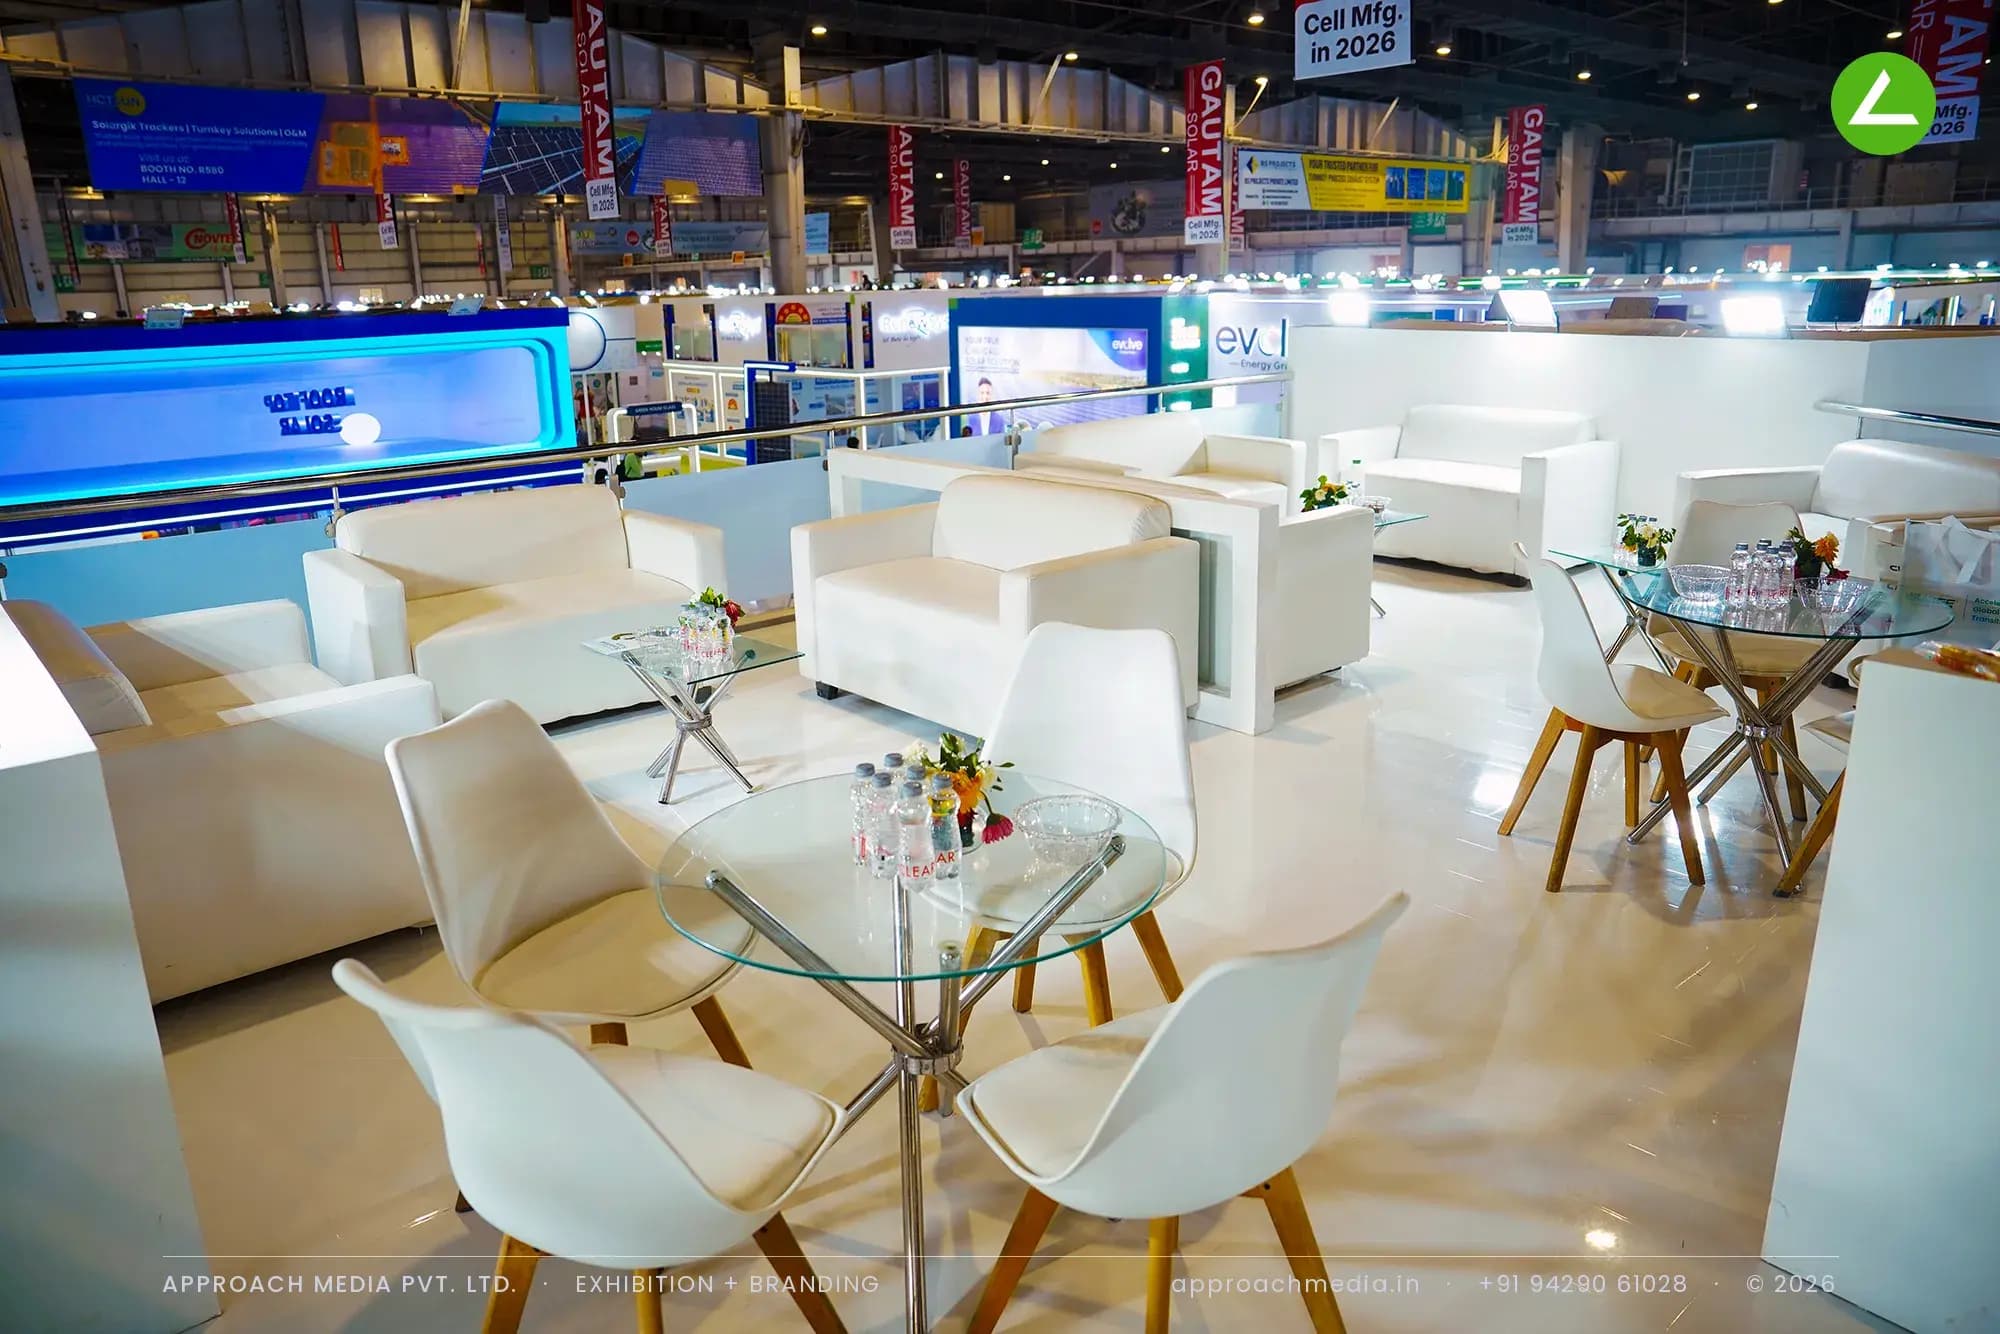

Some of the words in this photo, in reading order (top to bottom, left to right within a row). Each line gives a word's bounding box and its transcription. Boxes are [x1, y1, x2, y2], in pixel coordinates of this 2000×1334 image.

[1304, 8, 1345, 35] Cell
[1351, 1, 1403, 28] Mfg.
[1311, 42, 1330, 64] in
[1336, 30, 1396, 60] 2026
[140, 122, 185, 133] Trackers
[192, 125, 232, 136] Turnkey
[234, 127, 278, 136] Solutions
[284, 129, 307, 137] O&M
[1926, 121, 1965, 137] 026
[1186, 112, 1198, 172] SOLAR
[1201, 65, 1223, 215] GAUTAM
[140, 165, 177, 174] BOOTH
[179, 165, 197, 174] NO.
[889, 145, 898, 192] SOLAR
[1506, 143, 1520, 191] SOLAR
[1518, 108, 1544, 223] GAUTAM
[142, 176, 167, 184] HALL
[177, 176, 187, 185] 12
[899, 124, 915, 225] AUTAM
[590, 184, 601, 197] Cell
[960, 160, 971, 235] GAUTAM
[592, 200, 599, 212] in
[599, 199, 615, 211] 2026
[1188, 220, 1201, 230] Cell
[1203, 219, 1221, 231] Mfg.
[1506, 226, 1519, 234] Cell
[1191, 231, 1198, 240] in
[1199, 230, 1219, 239] 2026
[1241, 359, 1272, 371] Energy
